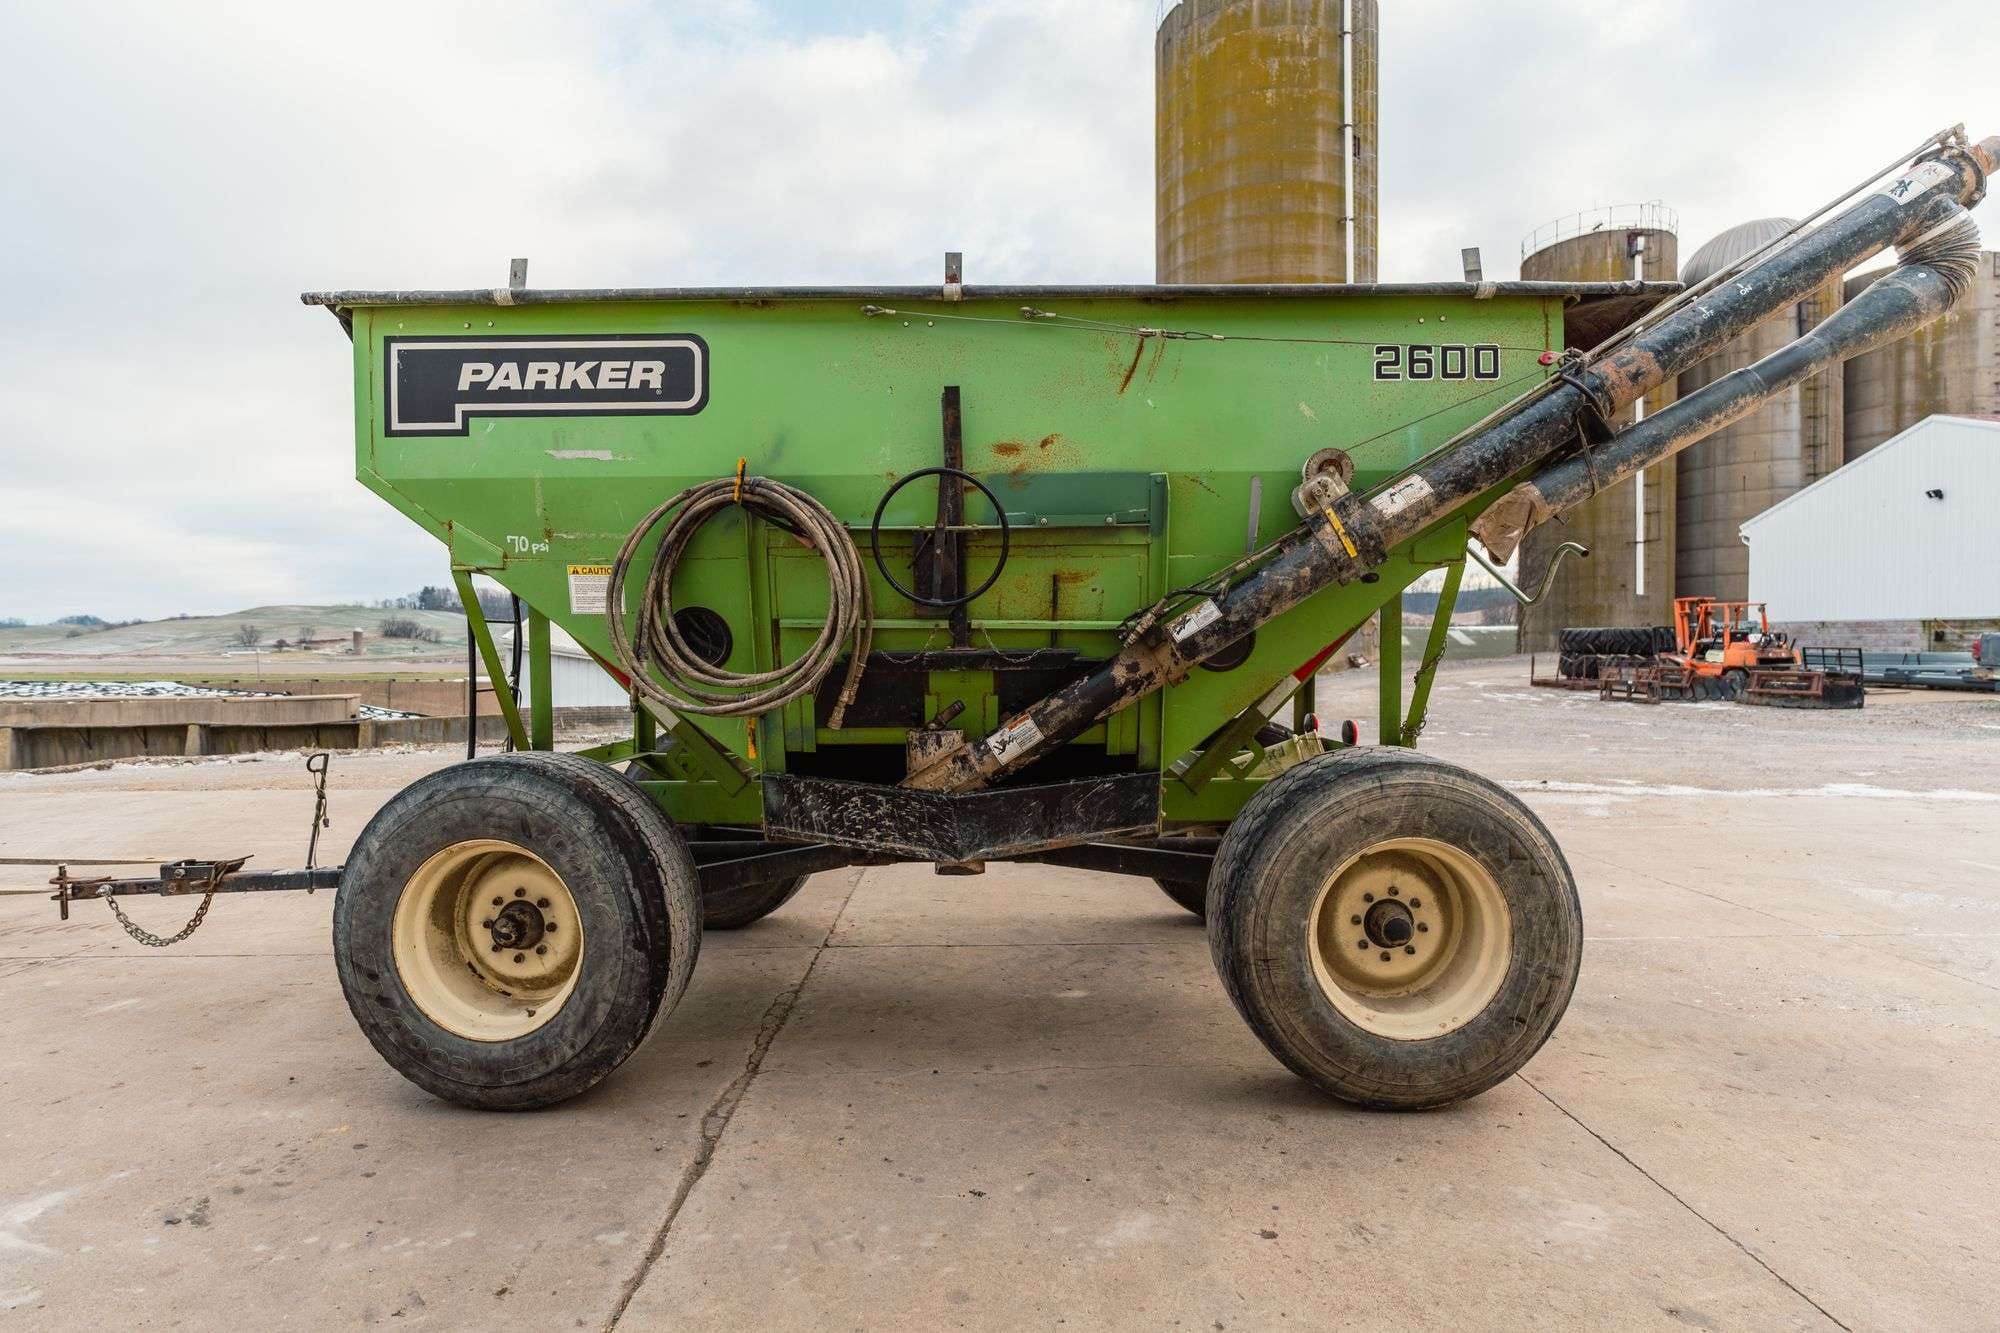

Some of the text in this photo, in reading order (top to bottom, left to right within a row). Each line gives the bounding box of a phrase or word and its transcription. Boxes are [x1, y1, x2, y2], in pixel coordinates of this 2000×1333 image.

[457, 360, 666, 392] PARKER
[1374, 343, 1500, 381] 2600
[507, 535, 549, 554] 70 psi
